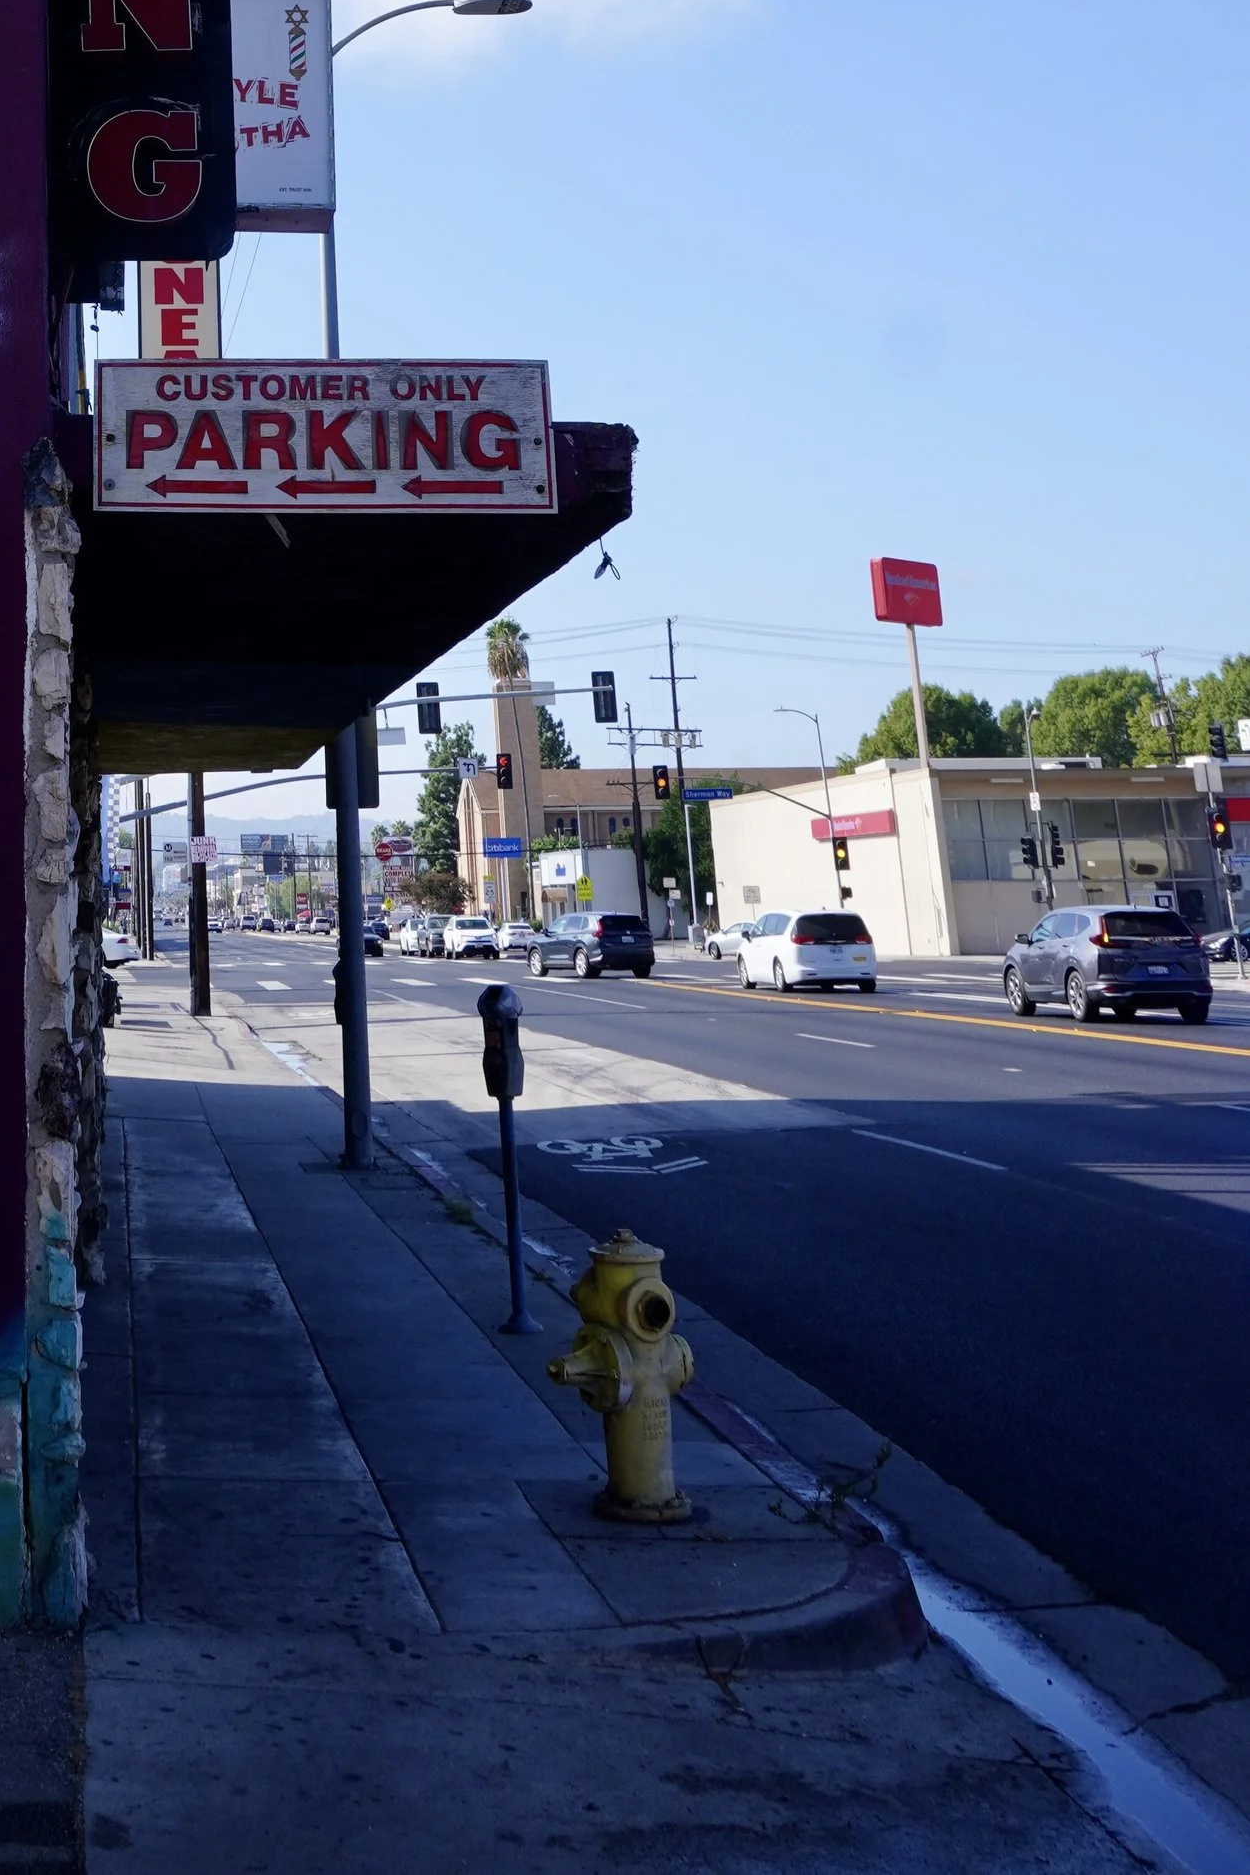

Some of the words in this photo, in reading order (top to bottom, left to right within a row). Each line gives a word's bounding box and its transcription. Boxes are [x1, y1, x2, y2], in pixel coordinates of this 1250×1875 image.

[234, 77, 300, 111] YLE
[235, 115, 312, 149] THA
[153, 259, 205, 360] NE
[156, 373, 370, 403] CUSTOMER
[389, 373, 487, 403] ONLY
[125, 408, 523, 471] PARKING
[191, 836, 216, 845] JUNK
[486, 843, 519, 853] citibank
